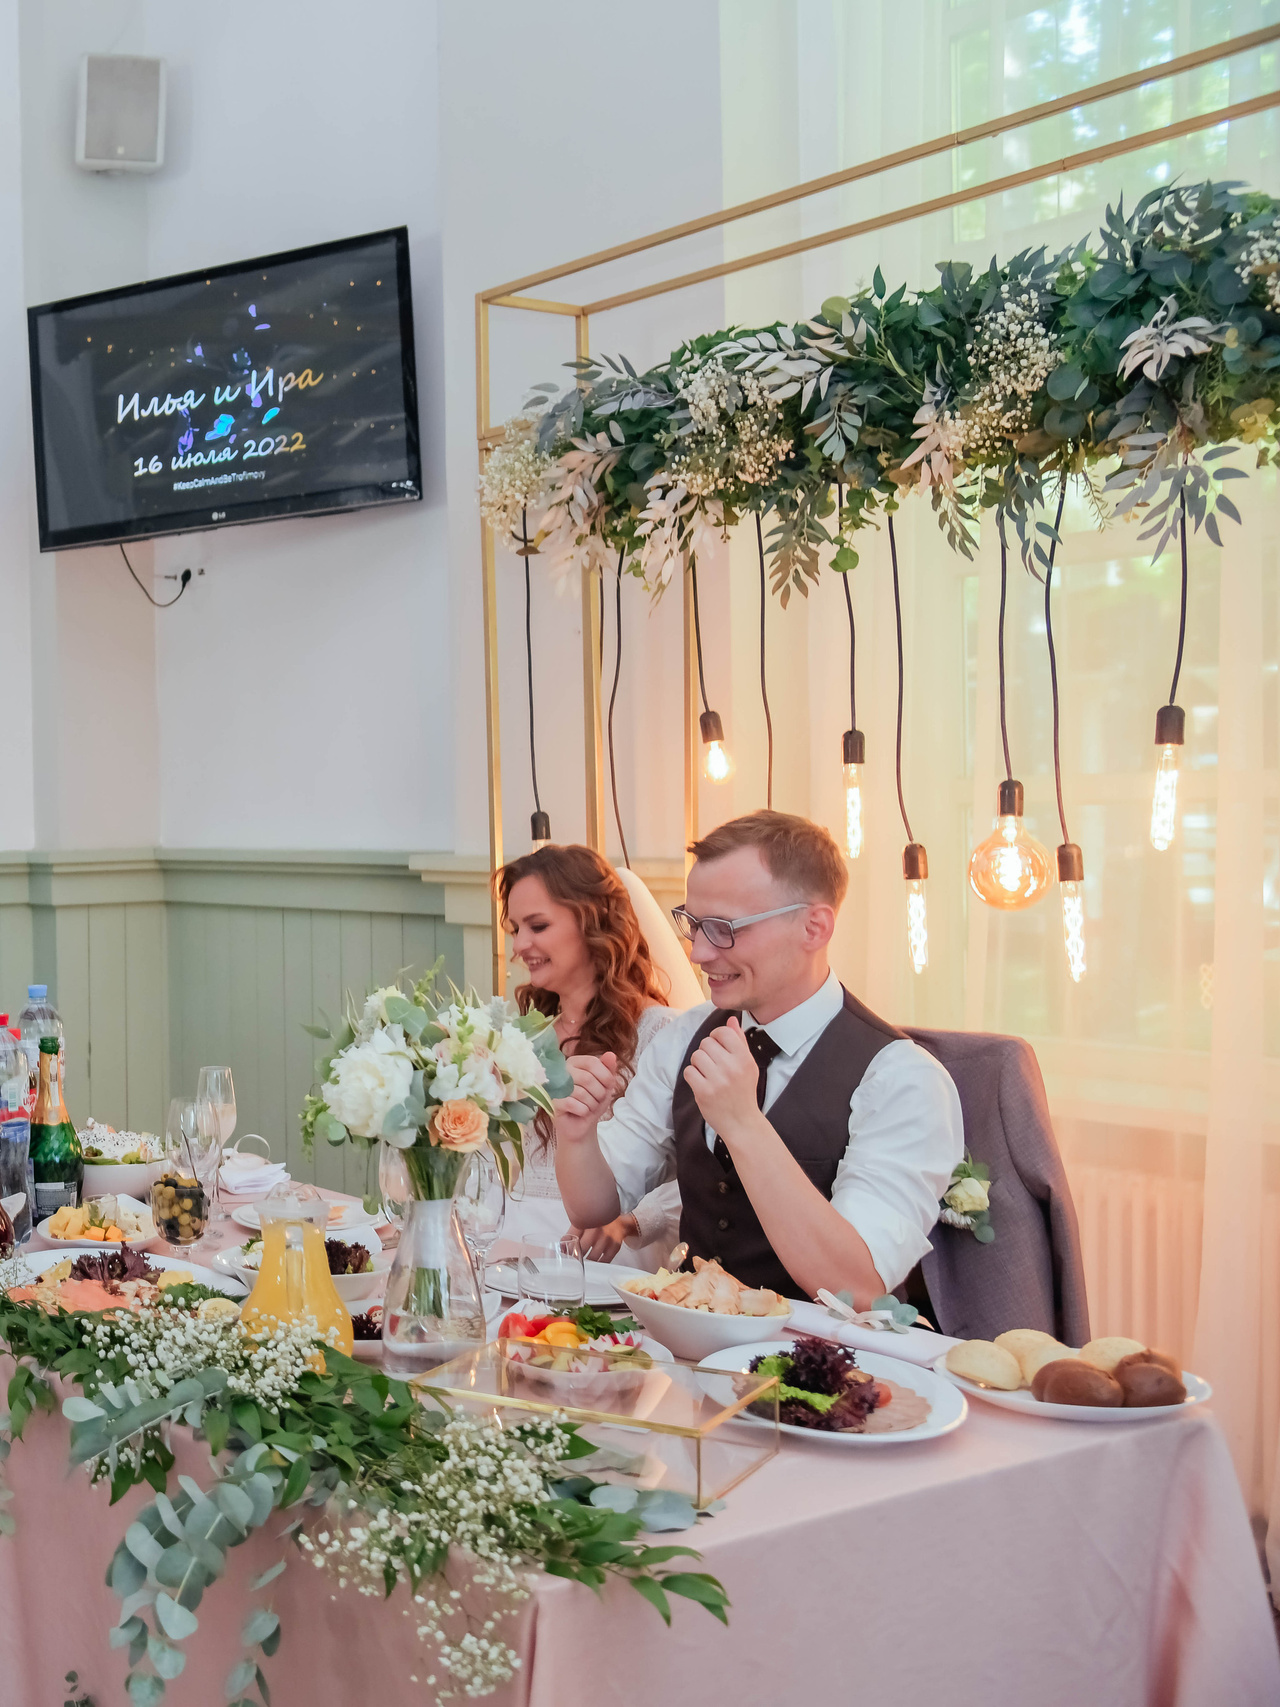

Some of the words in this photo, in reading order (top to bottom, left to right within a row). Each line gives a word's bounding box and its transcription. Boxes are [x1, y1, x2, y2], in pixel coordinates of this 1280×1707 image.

[117, 389, 206, 424] Илья
[213, 385, 242, 403] и
[250, 368, 324, 402] Ира
[133, 455, 163, 477] 16
[170, 447, 238, 470] июля
[242, 432, 306, 460] 2022
